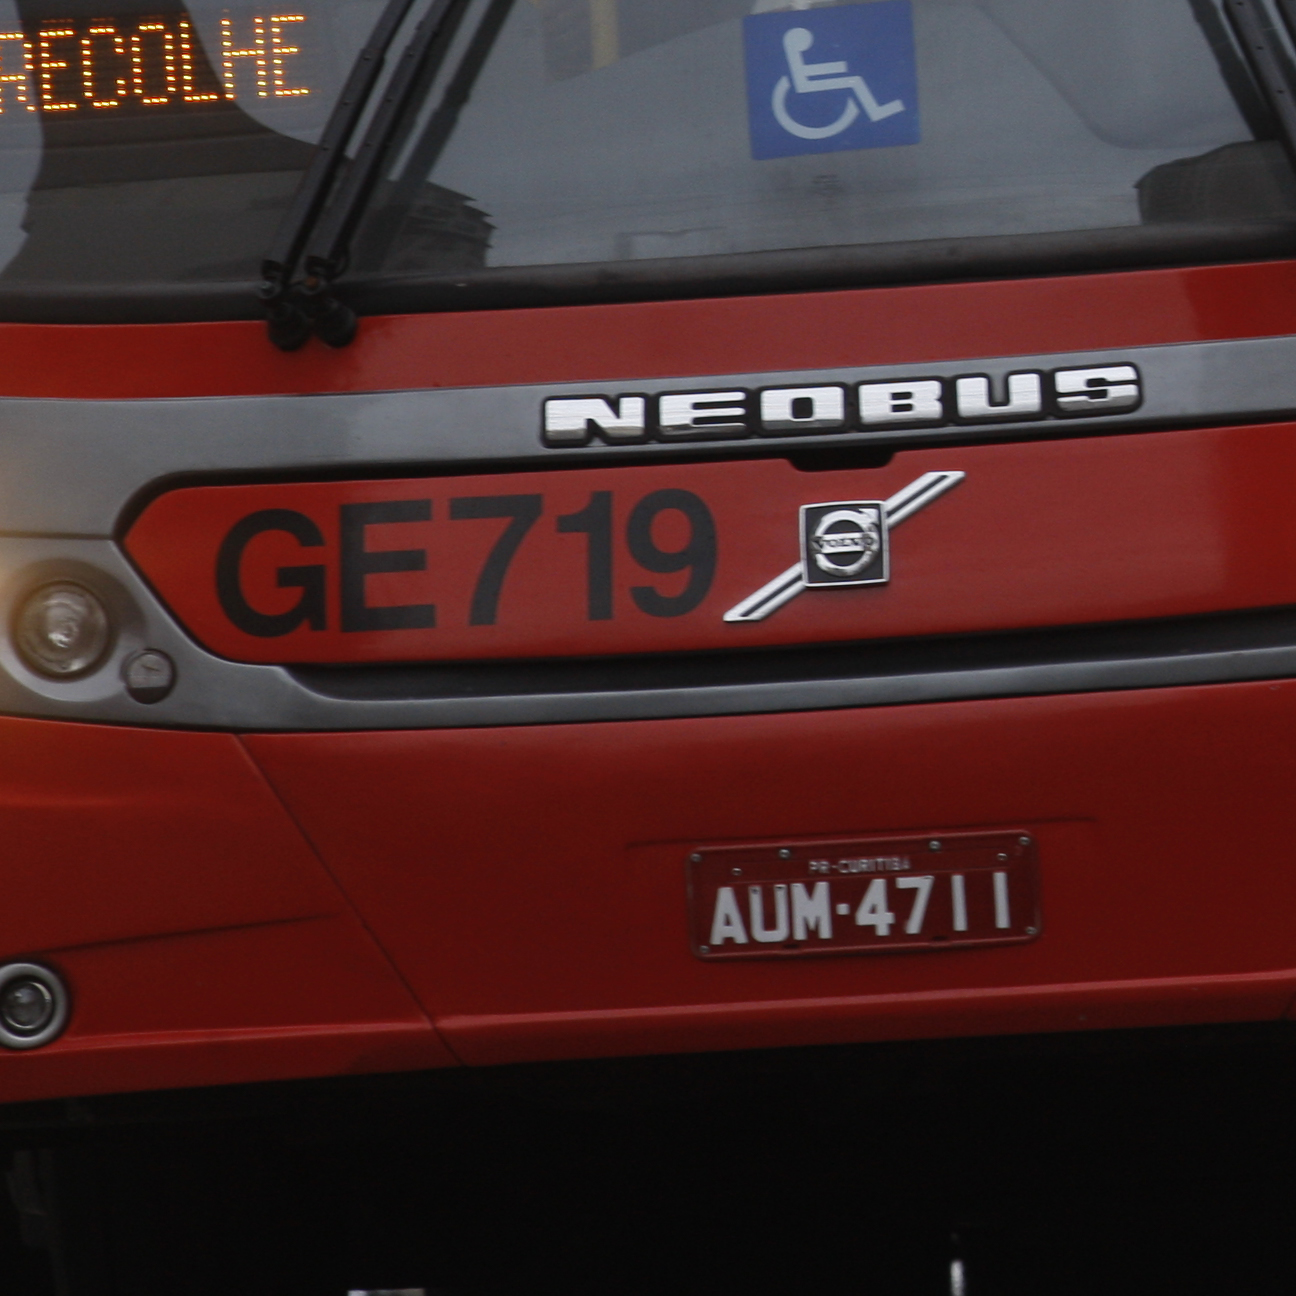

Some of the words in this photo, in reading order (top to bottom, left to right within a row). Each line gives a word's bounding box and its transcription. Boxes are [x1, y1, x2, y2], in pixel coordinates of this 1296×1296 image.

[0, 15, 310, 114] RECOLHE
[543, 364, 1140, 442] NEOBUS
[214, 487, 718, 638] GE719
